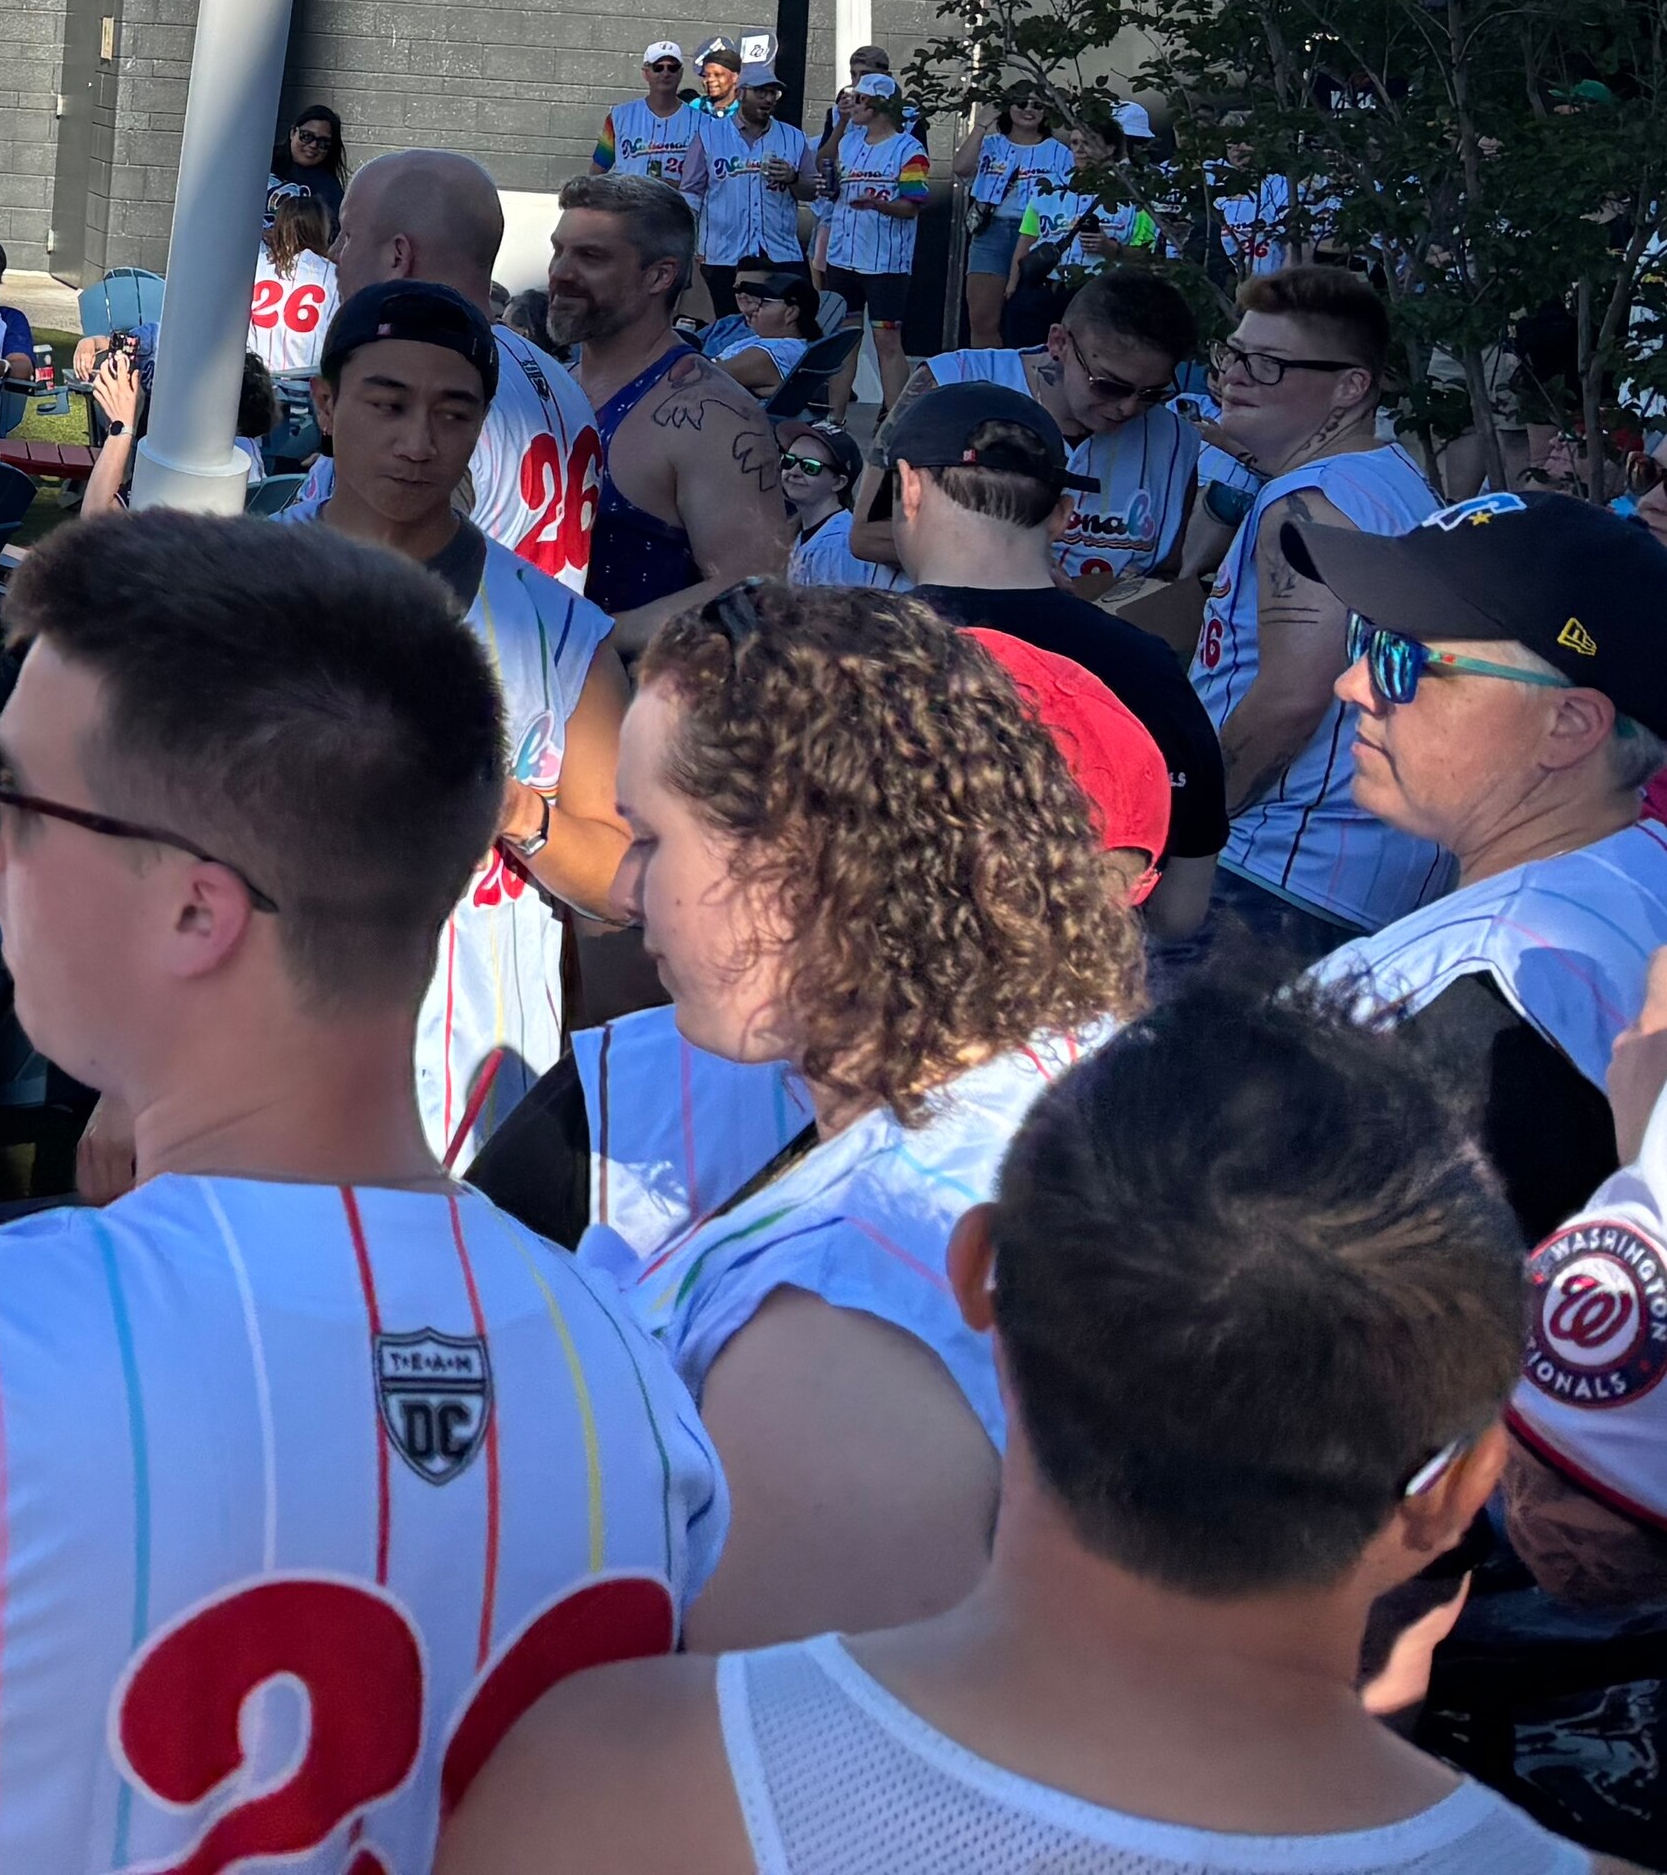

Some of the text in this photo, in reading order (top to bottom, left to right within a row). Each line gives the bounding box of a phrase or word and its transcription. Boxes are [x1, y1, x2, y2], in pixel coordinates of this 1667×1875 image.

[252, 279, 326, 333] 26
[513, 424, 604, 578] 26
[1549, 1228, 1667, 1342] WASHINGTON
[399, 1400, 472, 1461] DC
